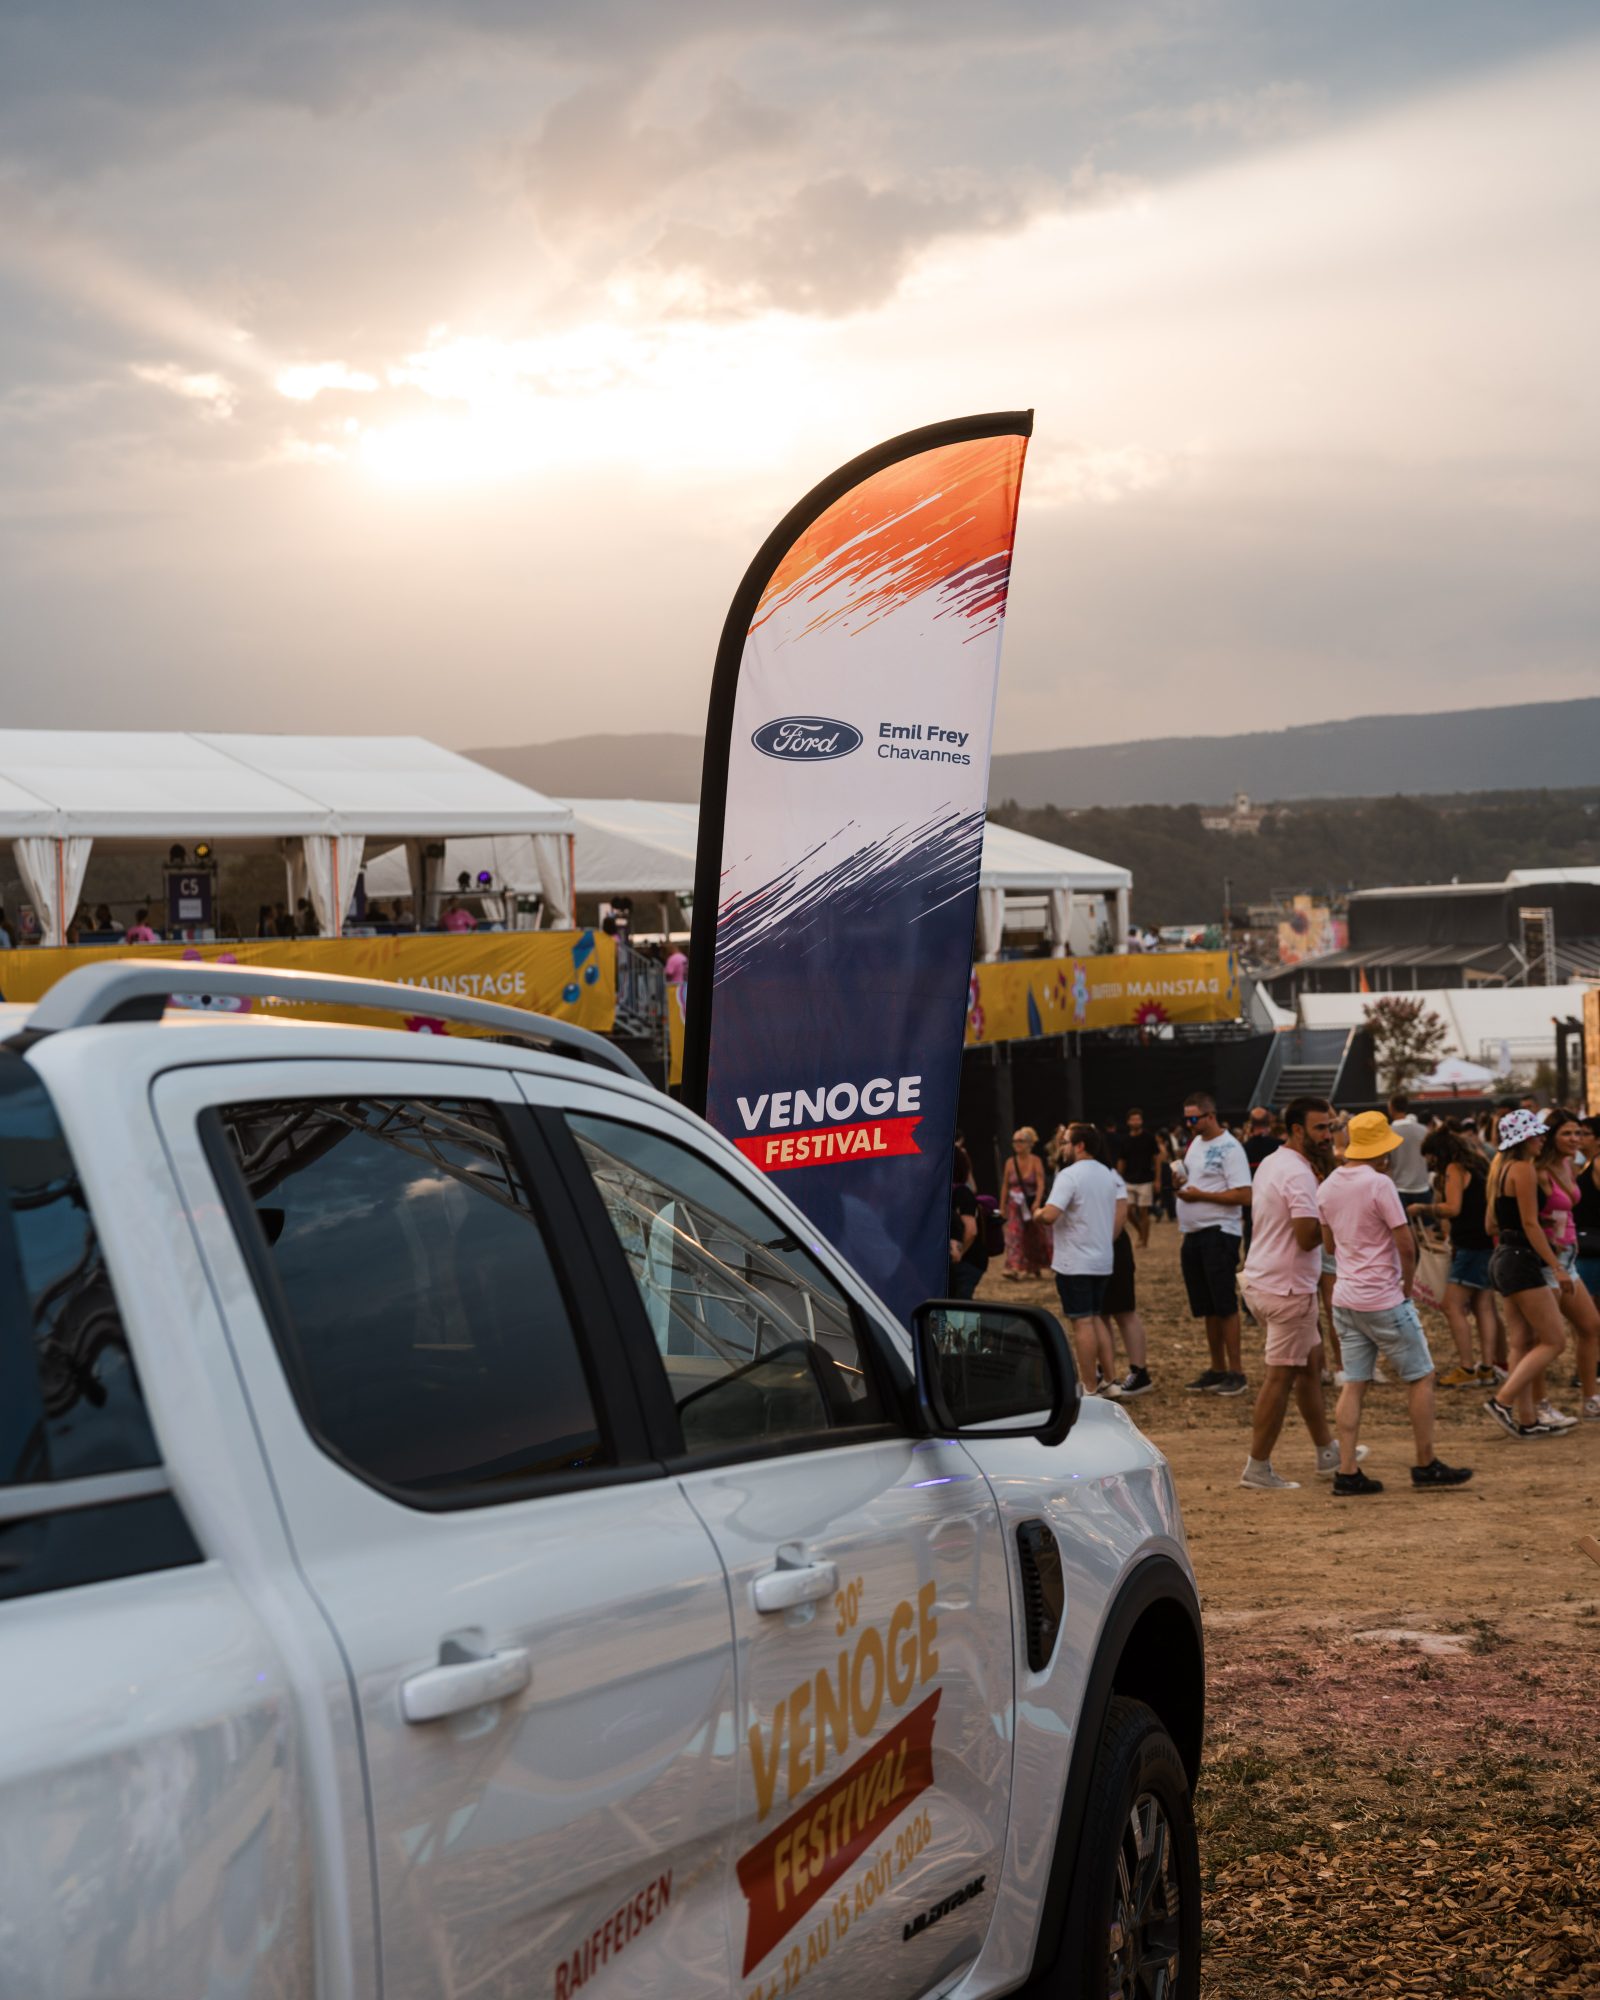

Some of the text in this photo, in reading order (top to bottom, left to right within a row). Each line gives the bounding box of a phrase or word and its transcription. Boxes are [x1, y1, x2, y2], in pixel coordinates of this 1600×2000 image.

[772, 723, 841, 753] Ford
[877, 744, 971, 765] Chavannes
[878, 722, 970, 747] Emil Frey
[736, 1075, 922, 1131] VENOGE
[765, 1127, 888, 1164] FESTIVAL
[748, 1579, 940, 1823] VENOGE
[773, 1736, 908, 1912] FESTIVAL
[783, 1946, 801, 1995] 12
[806, 1919, 830, 1974] AU
[832, 1893, 849, 1941] 15
[895, 1807, 933, 1873] 2026
[554, 1867, 673, 2000] RAIFFEISEN
